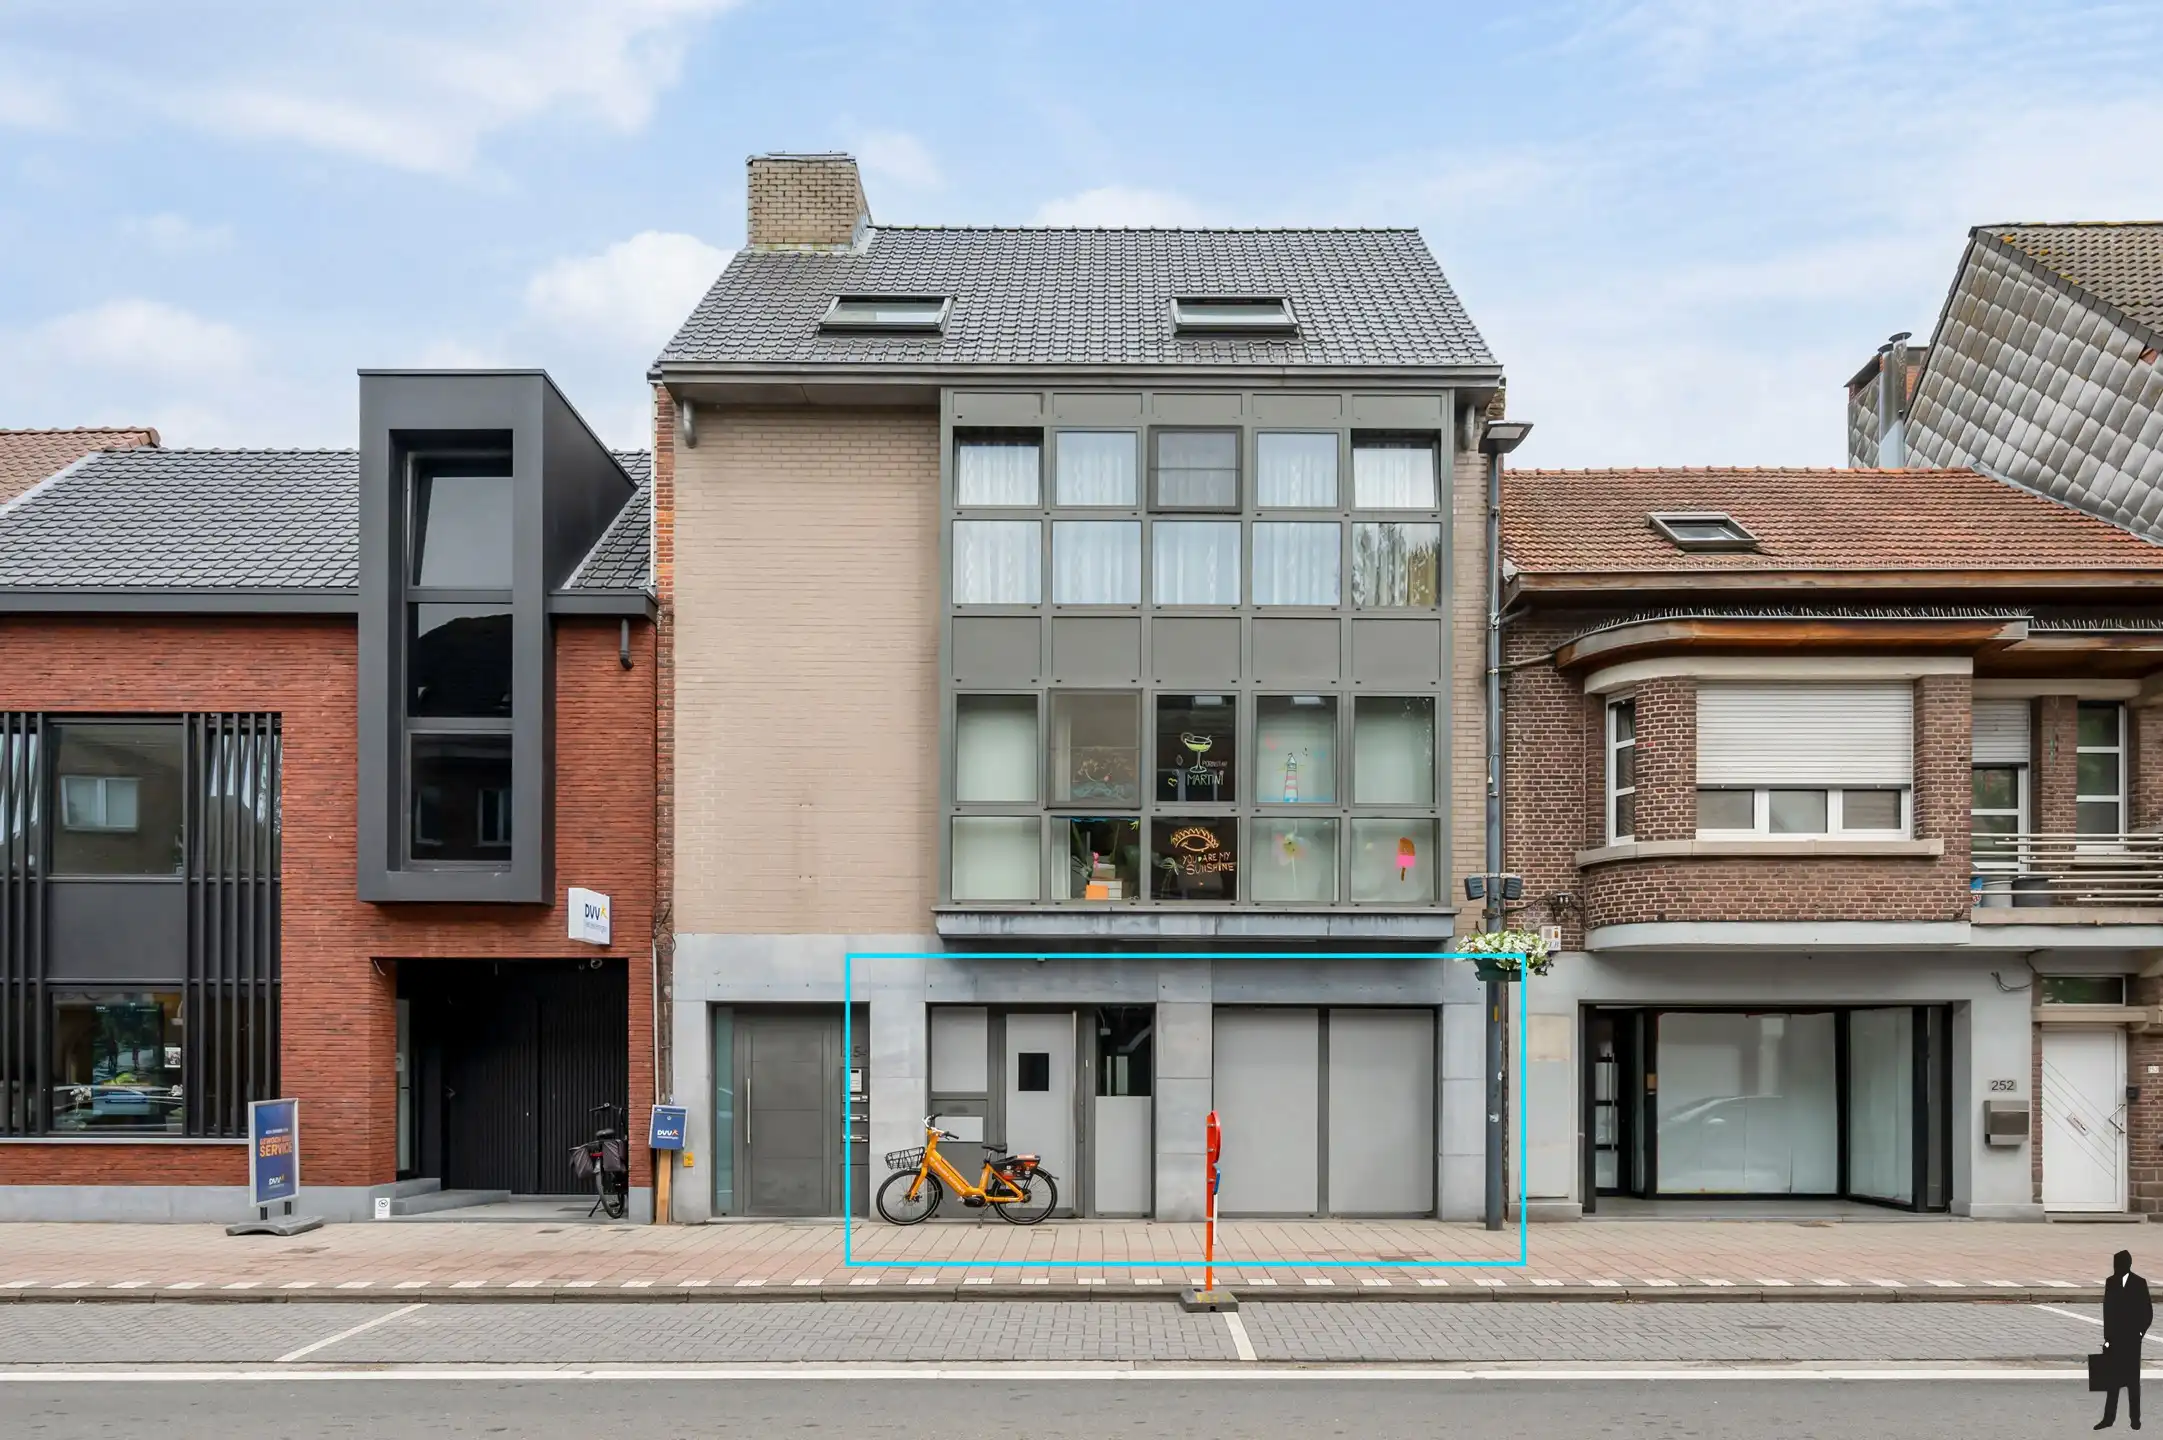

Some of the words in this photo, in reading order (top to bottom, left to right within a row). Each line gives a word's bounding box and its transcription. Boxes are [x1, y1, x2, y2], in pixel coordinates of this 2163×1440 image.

[1187, 773, 1224, 786] MARTINI
[1183, 854, 1197, 865] YOU
[1202, 852, 1218, 862] ARE
[1220, 851, 1231, 861] MY
[1186, 862, 1235, 875] SUNSHINE
[585, 903, 600, 920] DVV
[1991, 1080, 2015, 1091] 252
[260, 1142, 293, 1158] SERVICE
